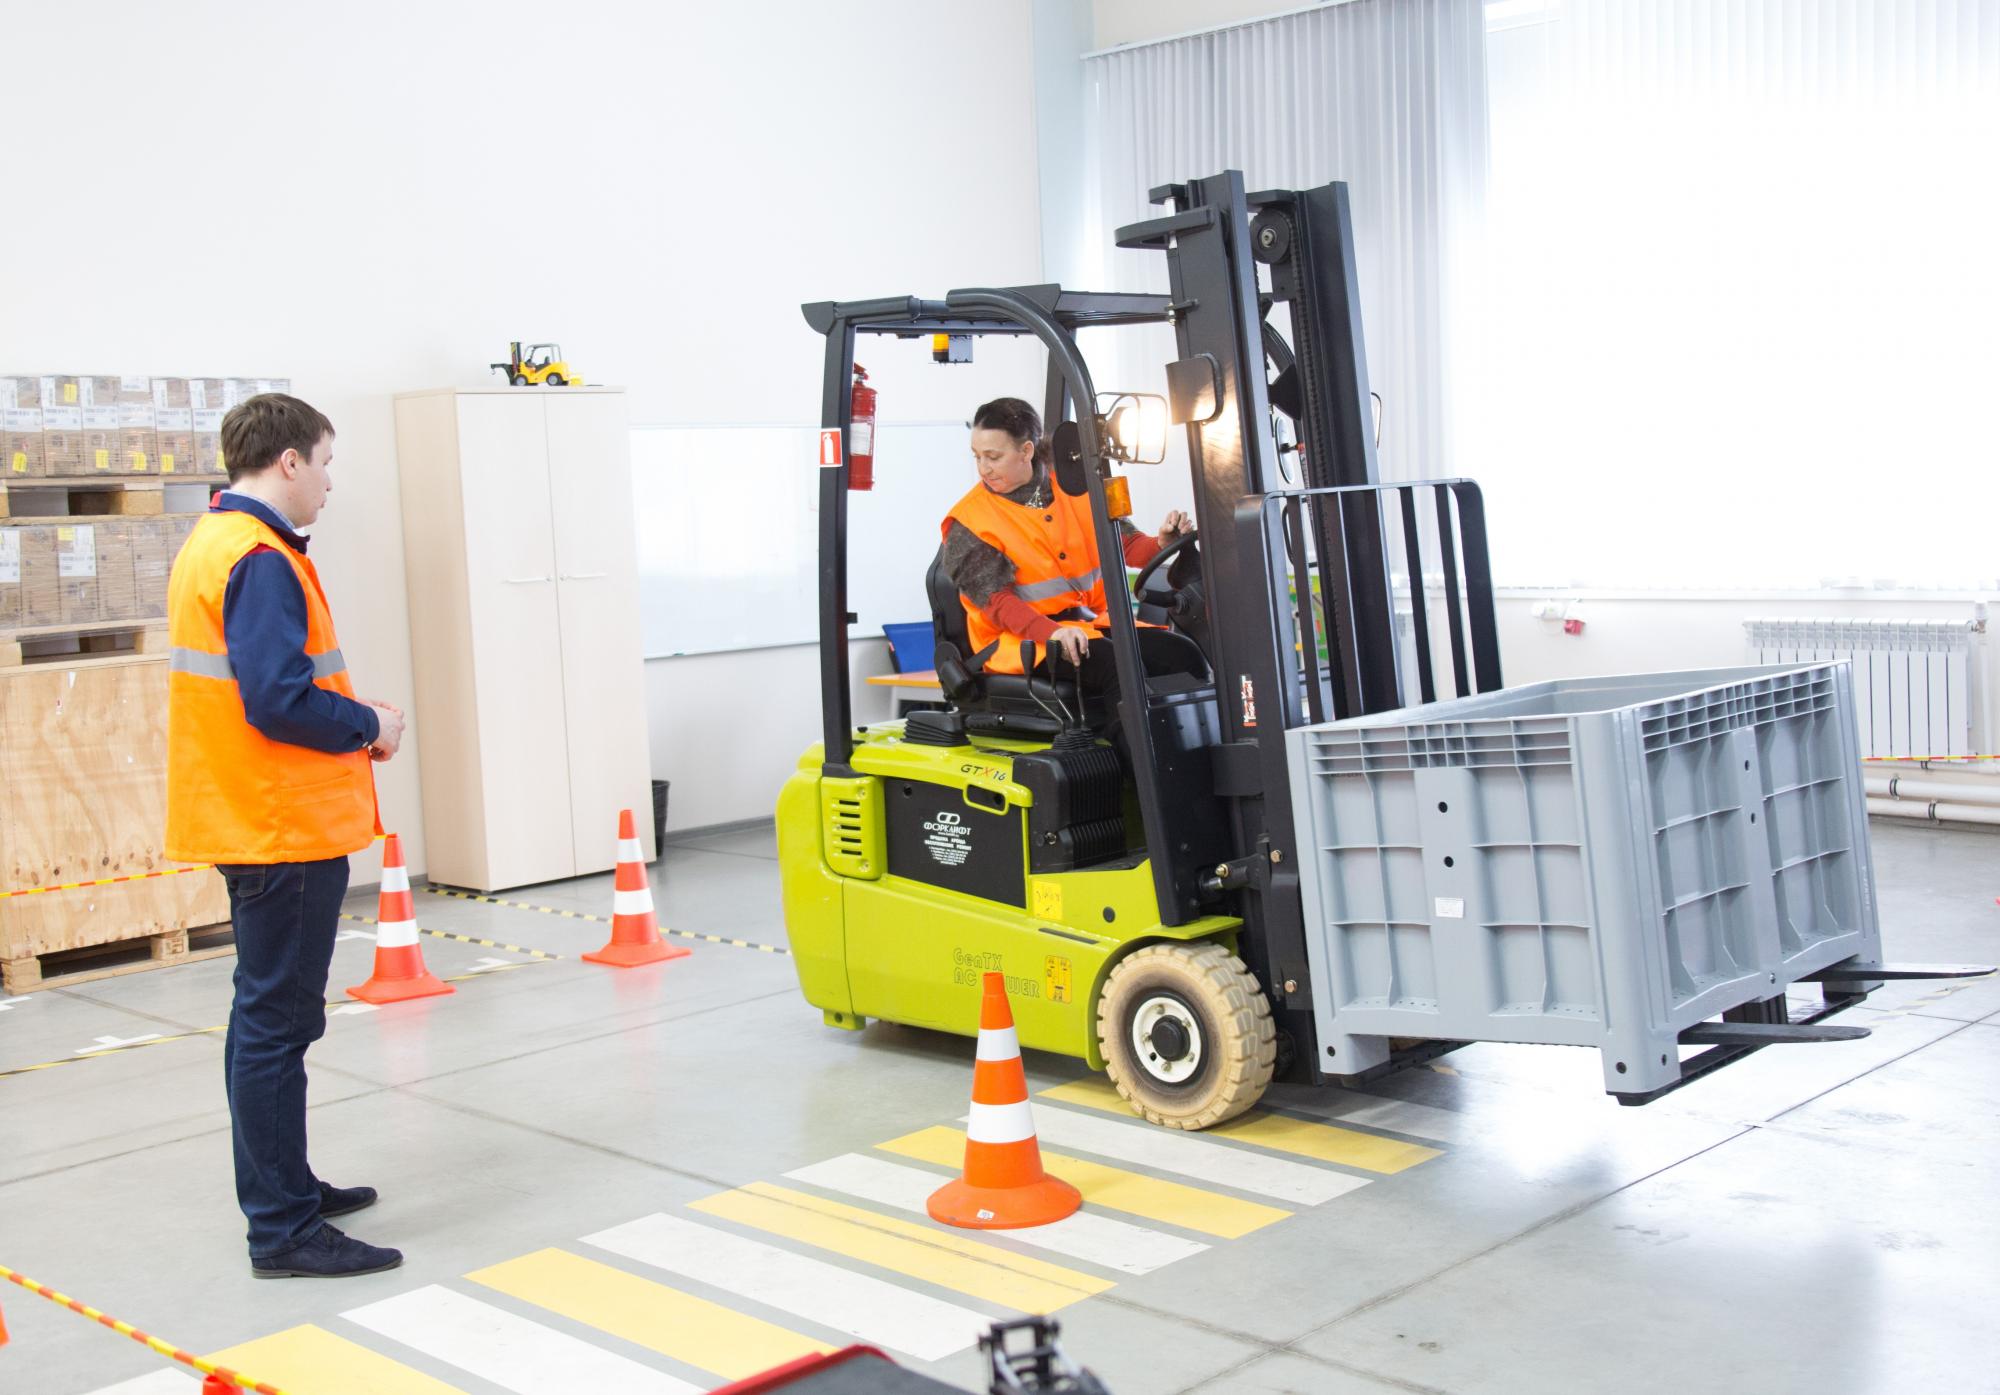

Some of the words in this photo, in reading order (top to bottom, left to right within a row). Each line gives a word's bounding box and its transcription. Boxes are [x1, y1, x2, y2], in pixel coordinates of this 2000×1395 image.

[953, 947, 1004, 972] GenTX
[953, 966, 977, 986] AC
[1005, 975, 1040, 998] WER
